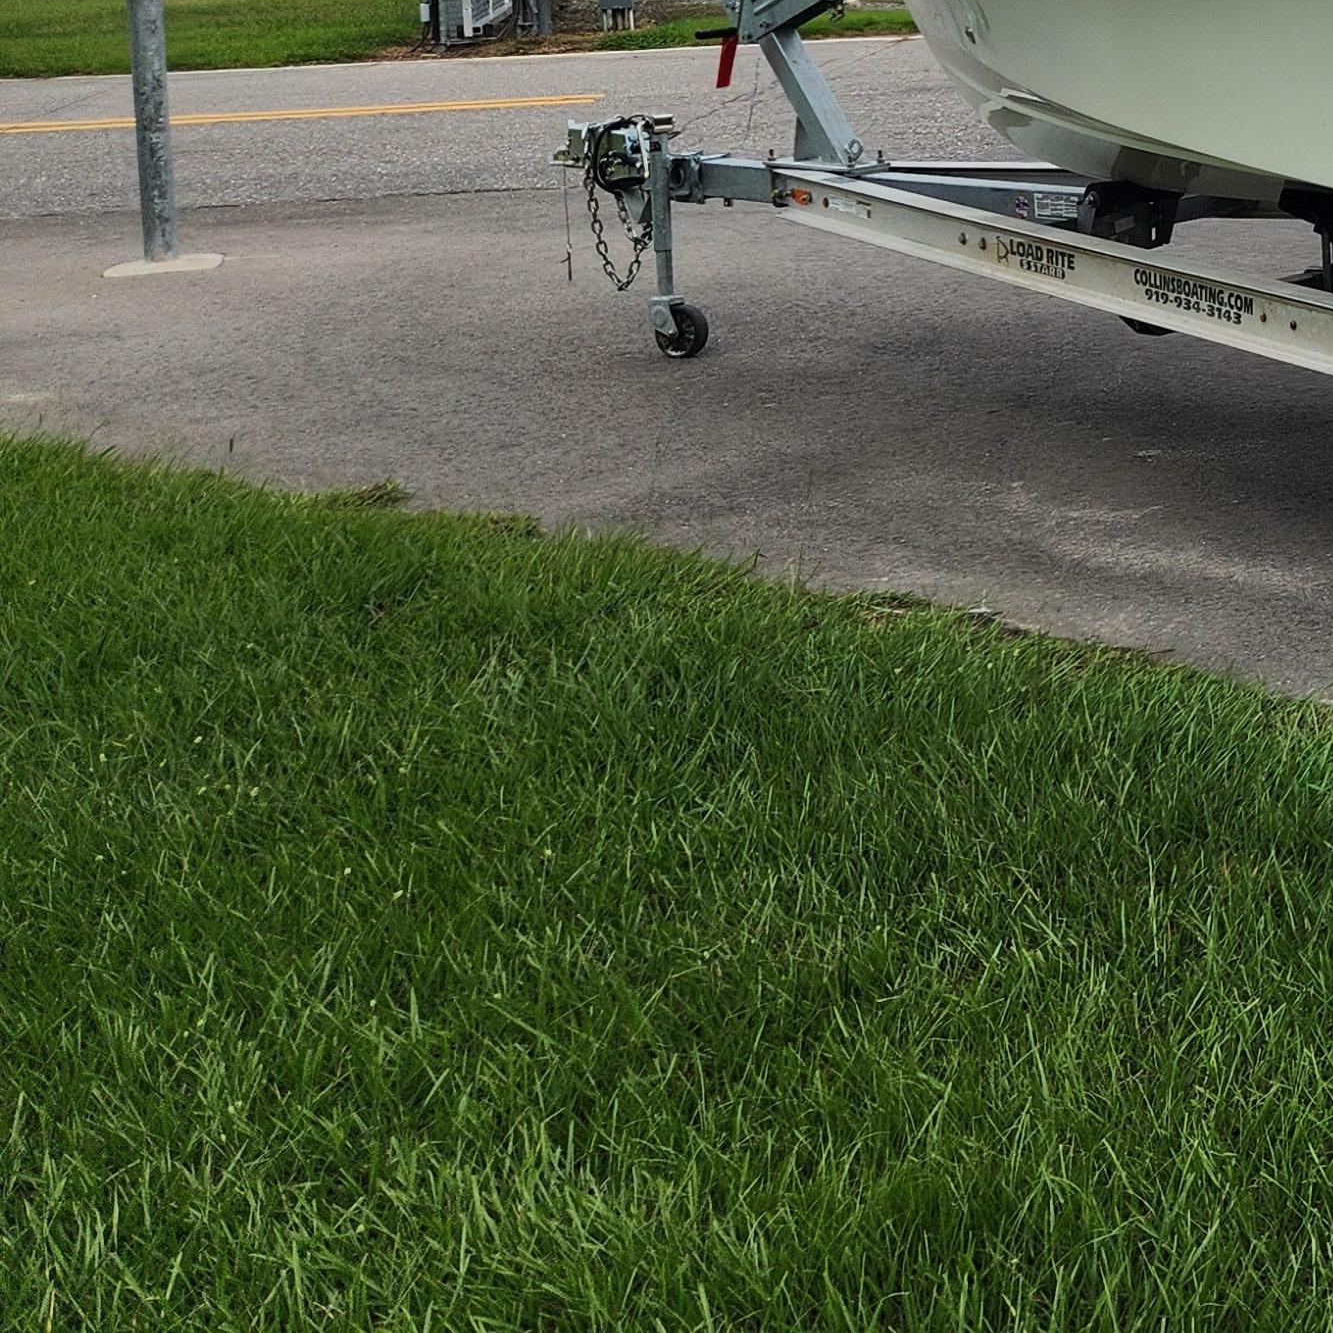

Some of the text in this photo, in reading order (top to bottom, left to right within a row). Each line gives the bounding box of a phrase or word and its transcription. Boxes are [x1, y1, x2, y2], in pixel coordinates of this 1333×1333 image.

[1009, 239, 1075, 271] LOAD RITE
[1134, 268, 1254, 315] COLLINSBOATING.COM
[1145, 288, 1242, 325] 919-934-3143
